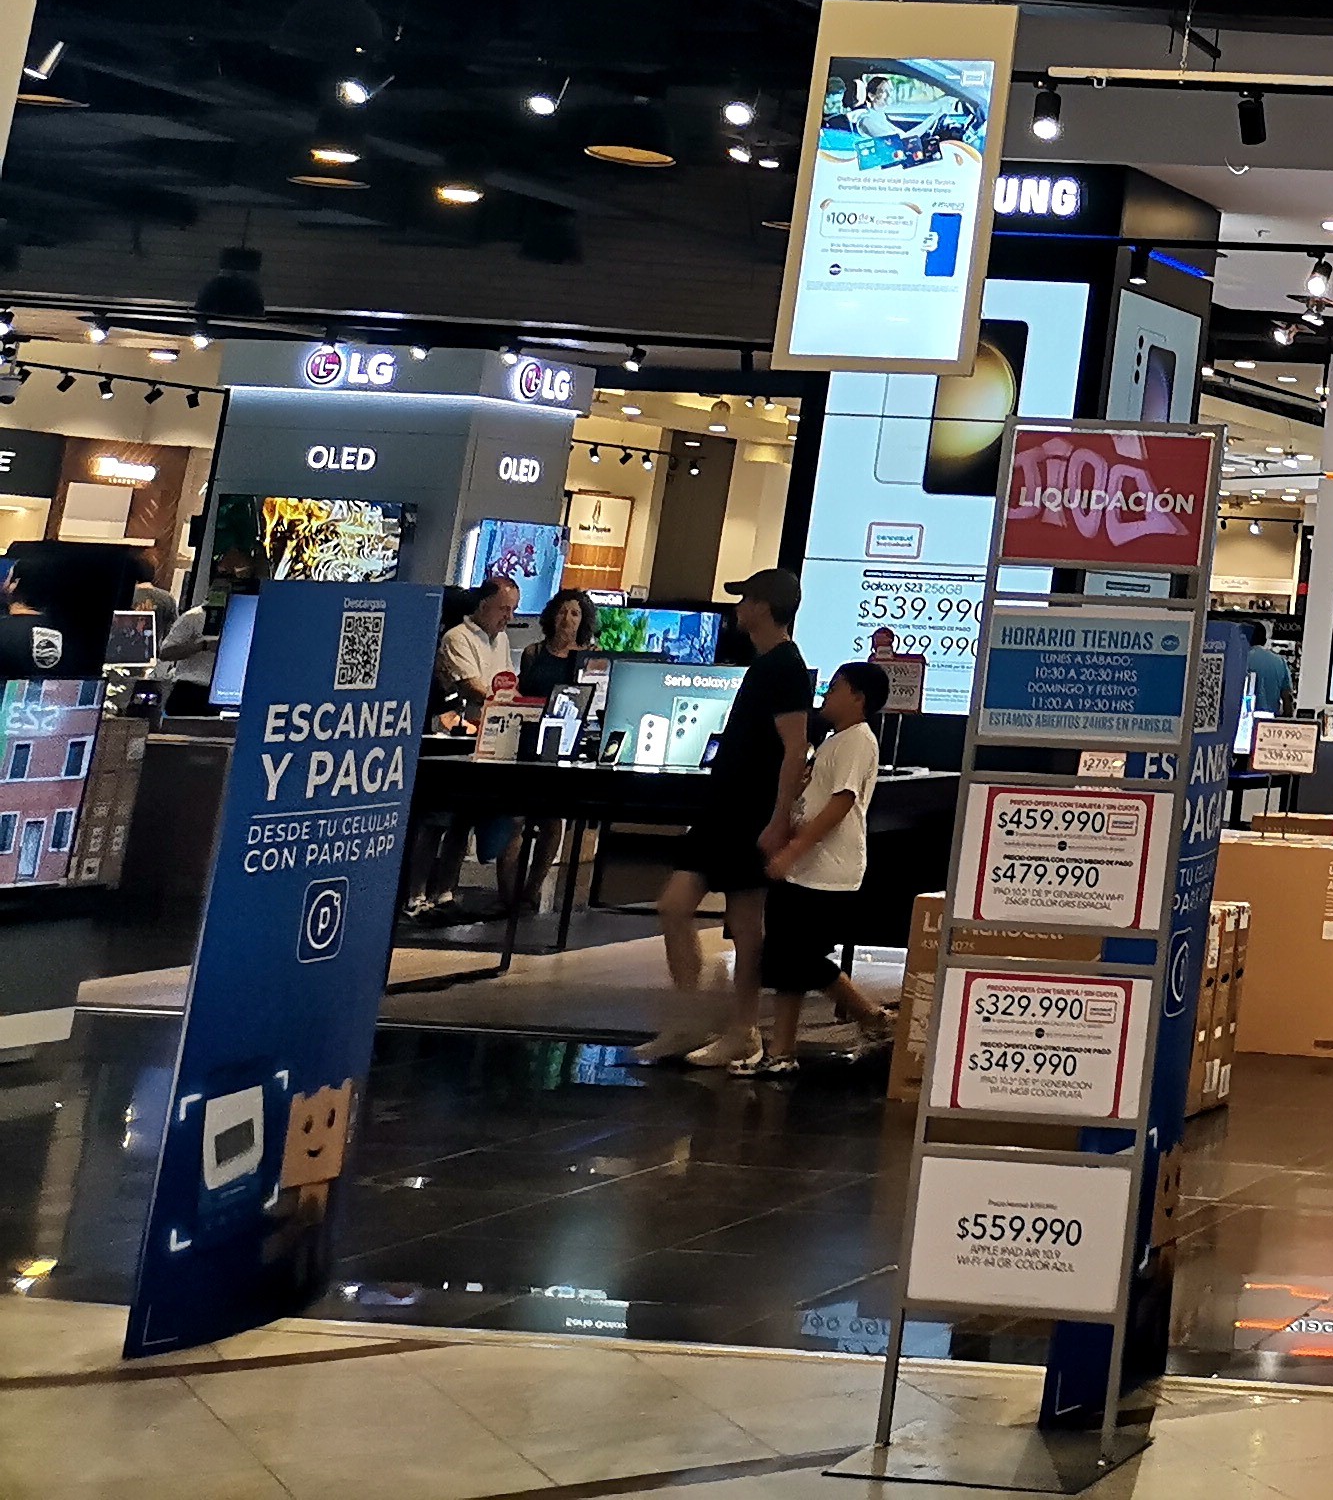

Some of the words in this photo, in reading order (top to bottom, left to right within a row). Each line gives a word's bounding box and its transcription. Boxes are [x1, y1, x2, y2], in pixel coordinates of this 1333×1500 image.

[348, 353, 394, 385] LG
[542, 367, 571, 401] LG
[307, 445, 377, 471] OLED
[499, 455, 540, 484] OLED
[1018, 485, 1196, 515] LIQUIDACIÓN
[861, 580, 903, 595] Galaxy
[904, 581, 924, 594] S23
[925, 583, 963, 596] 256GB
[1000, 625, 1076, 648] HORARIO
[1082, 629, 1154, 651] TIENDAS
[1039, 653, 1072, 664] LUNES
[1074, 655, 1084, 665] A
[663, 674, 692, 688] Serie
[693, 675, 731, 691] Galaxy
[1035, 666, 1065, 680] 10:30
[1067, 669, 1078, 680] A
[1114, 670, 1138, 683] HRS
[1027, 682, 1085, 694] DOMINGO
[1086, 684, 1095, 695] Y
[1065, 698, 1076, 710] A
[1111, 700, 1135, 712] HRS
[263, 700, 412, 743] ESCANEA
[989, 711, 1032, 727] ESTAMOS
[1116, 716, 1129, 731] EN
[261, 752, 294, 801] Y
[305, 746, 404, 799] PAGA
[247, 818, 309, 845] DESDE
[317, 819, 336, 838] TU
[341, 810, 399, 835] CELULAR
[997, 807, 1106, 834] $459.990
[243, 847, 297, 874] CON
[305, 838, 361, 868] PARIS
[365, 833, 395, 859] APP
[990, 862, 1100, 888] $479.990
[974, 993, 1084, 1021] $329.990
[968, 1049, 1077, 1077] $349.990
[956, 1212, 1082, 1247] $559.990
